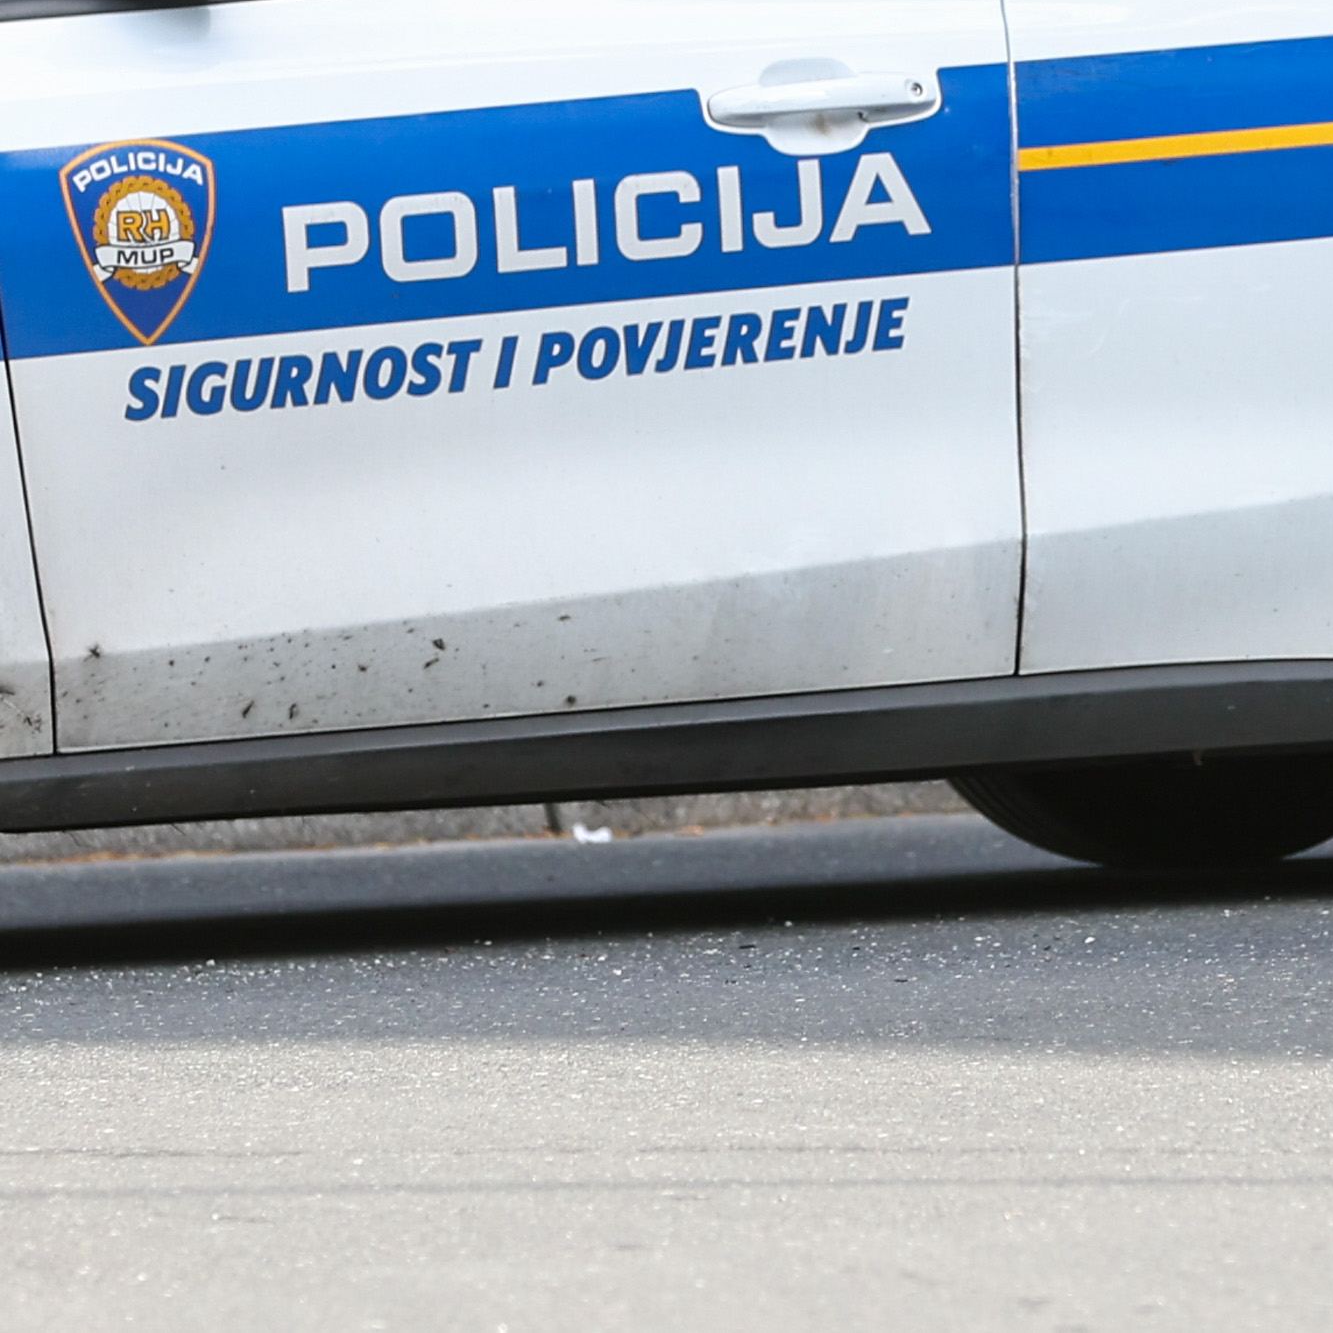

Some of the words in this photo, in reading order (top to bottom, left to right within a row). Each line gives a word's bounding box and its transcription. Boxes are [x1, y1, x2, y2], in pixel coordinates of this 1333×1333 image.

[72, 151, 204, 193] POLICIJA
[116, 209, 171, 243] RH
[282, 152, 932, 293] POLICIJA
[116, 247, 175, 266] MUP
[125, 339, 483, 421] SIGURNOST
[493, 335, 519, 389] I
[532, 297, 910, 386] POVJERENJE
